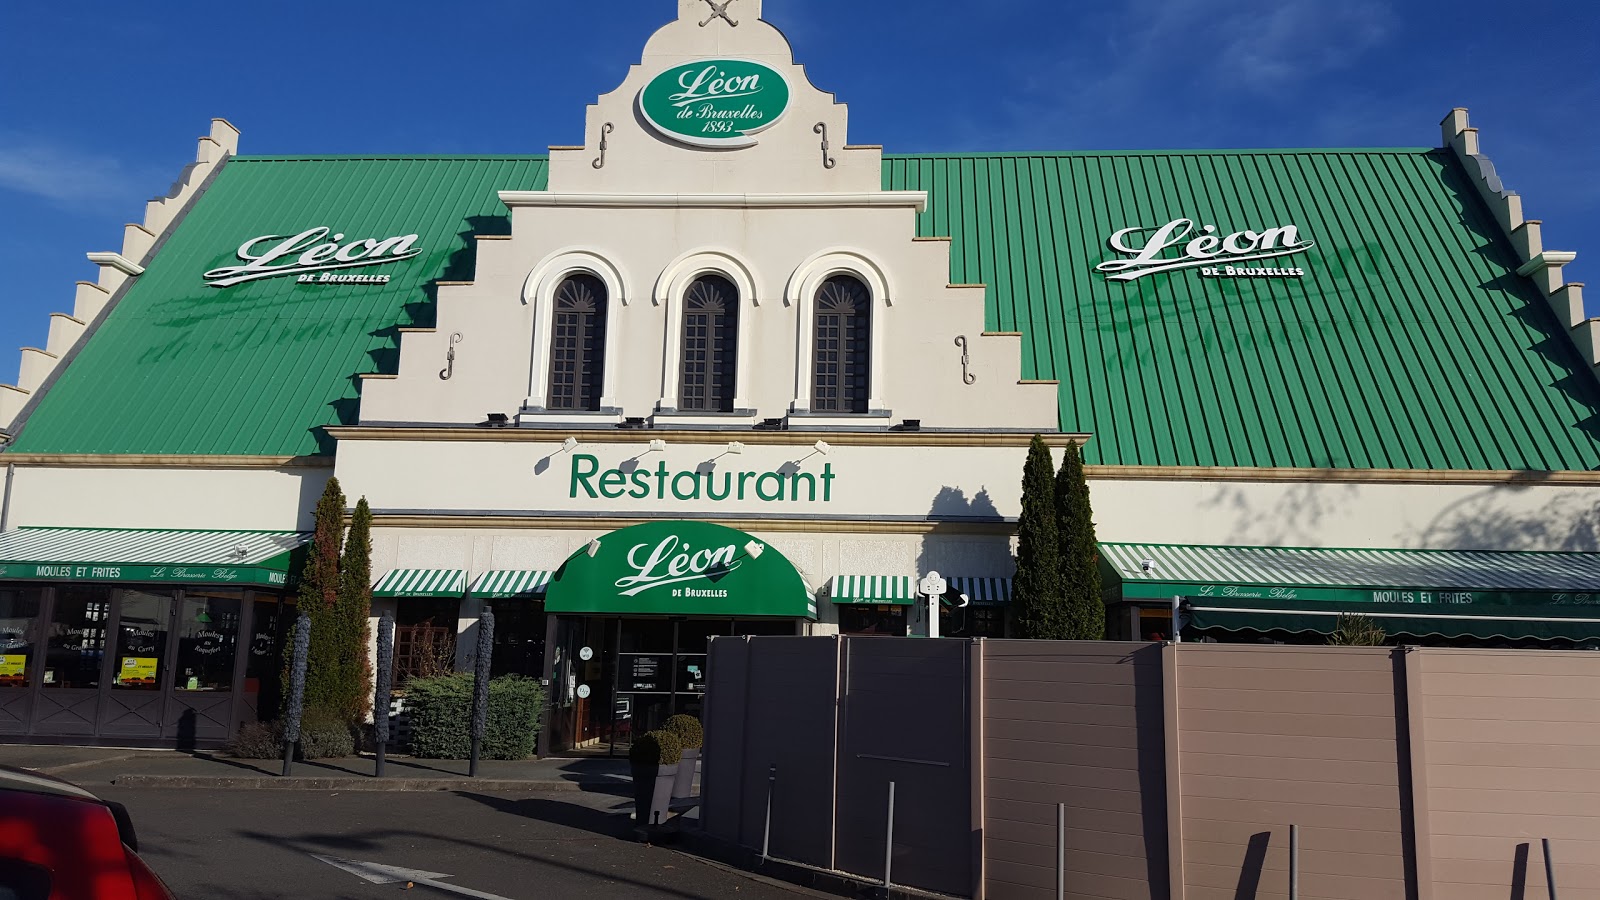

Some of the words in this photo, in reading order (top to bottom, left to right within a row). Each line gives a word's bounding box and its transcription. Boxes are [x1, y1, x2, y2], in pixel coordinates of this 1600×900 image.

[668, 65, 763, 106] Léon
[676, 105, 693, 119] de
[695, 103, 763, 119] Bruxelles
[701, 120, 734, 133] 1893
[1096, 217, 1315, 281] Léon
[203, 226, 423, 287] Léon
[1202, 267, 1220, 276] DE
[1226, 265, 1305, 276] BRUXELLES
[298, 274, 315, 283] DE
[319, 272, 391, 283] BRUXELLES
[569, 453, 836, 502] Restaurant
[36, 565, 71, 578] MOULES
[76, 566, 87, 578] ET
[92, 567, 121, 578] FRITES
[615, 534, 743, 597] Léon
[150, 566, 165, 578] La
[170, 567, 206, 579] Brasserie
[212, 568, 237, 580] Belge
[268, 572, 288, 584] MOULES
[672, 588, 682, 597] DE
[685, 587, 728, 598] BRUXELLES
[1198, 584, 1215, 597] La
[1221, 585, 1262, 598] Brasserie
[1269, 586, 1298, 600] Belge
[1373, 591, 1414, 603] MOULES
[1420, 592, 1433, 604] ET
[1439, 592, 1473, 604] FRITES
[194, 644, 221, 655] Roquefort
